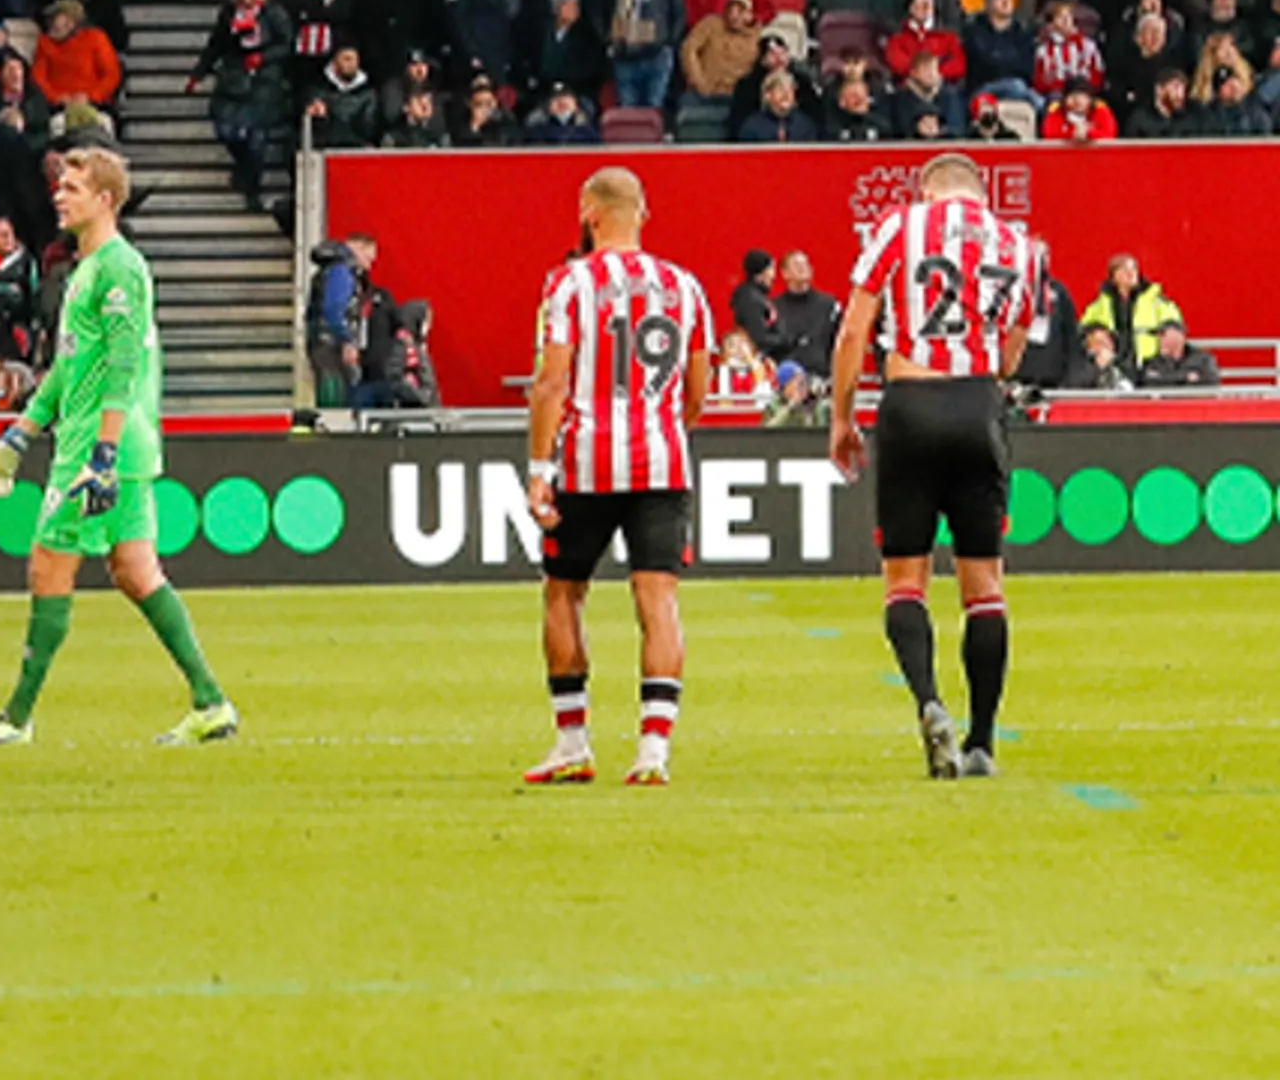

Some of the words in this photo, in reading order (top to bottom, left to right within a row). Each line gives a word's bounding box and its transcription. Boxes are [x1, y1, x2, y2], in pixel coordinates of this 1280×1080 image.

[914, 255, 1018, 337] 27
[607, 315, 681, 398] 19
[389, 458, 847, 566] UNET
